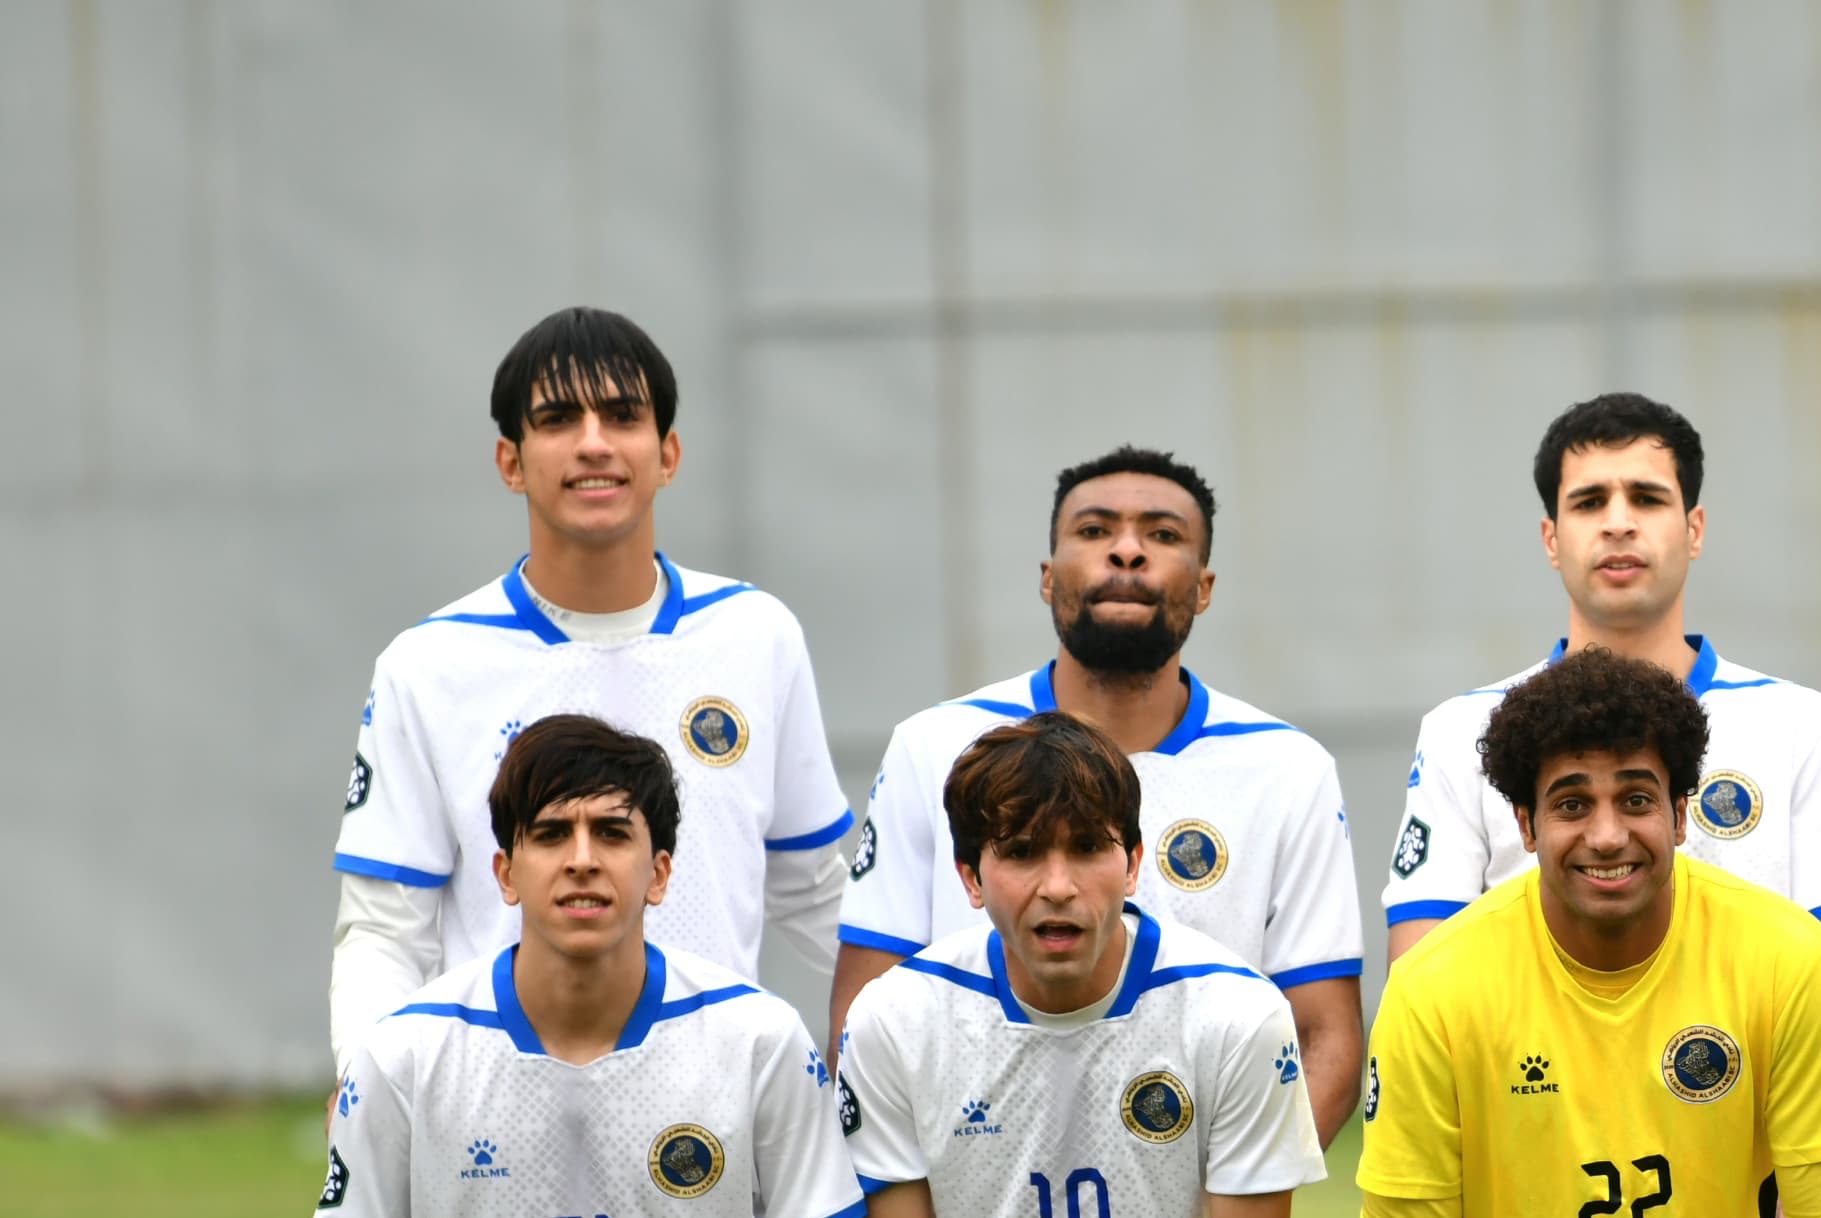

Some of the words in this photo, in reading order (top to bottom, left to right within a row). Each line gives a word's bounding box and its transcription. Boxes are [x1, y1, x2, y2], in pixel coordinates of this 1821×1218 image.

[1511, 1083, 1560, 1095] KELME
[953, 1124, 1002, 1137] KELME
[460, 1168, 511, 1179] KELME
